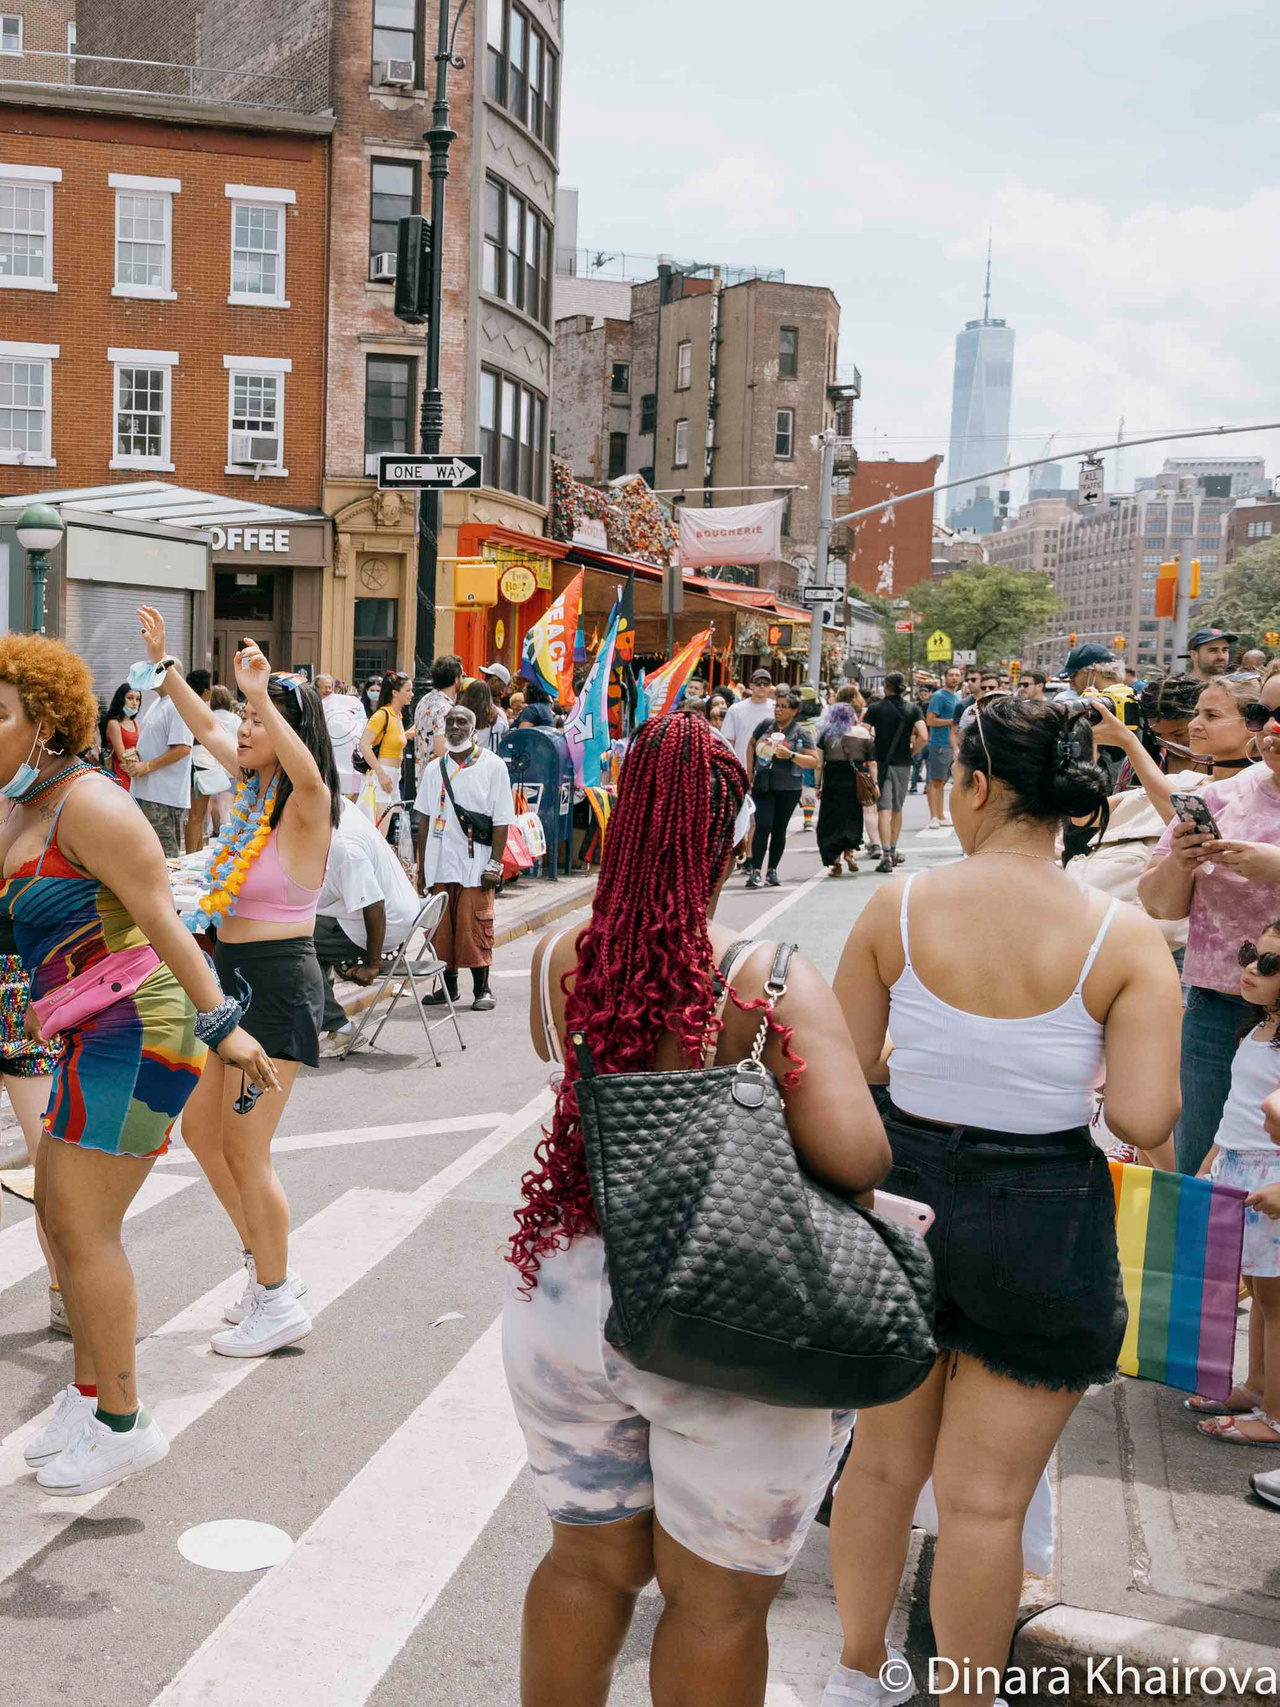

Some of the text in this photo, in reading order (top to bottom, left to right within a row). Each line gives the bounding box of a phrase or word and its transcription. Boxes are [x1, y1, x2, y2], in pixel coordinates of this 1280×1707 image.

[394, 466, 466, 479] ONE WAY
[695, 525, 764, 539] BOUCHERIE
[208, 527, 290, 552] OFFEE
